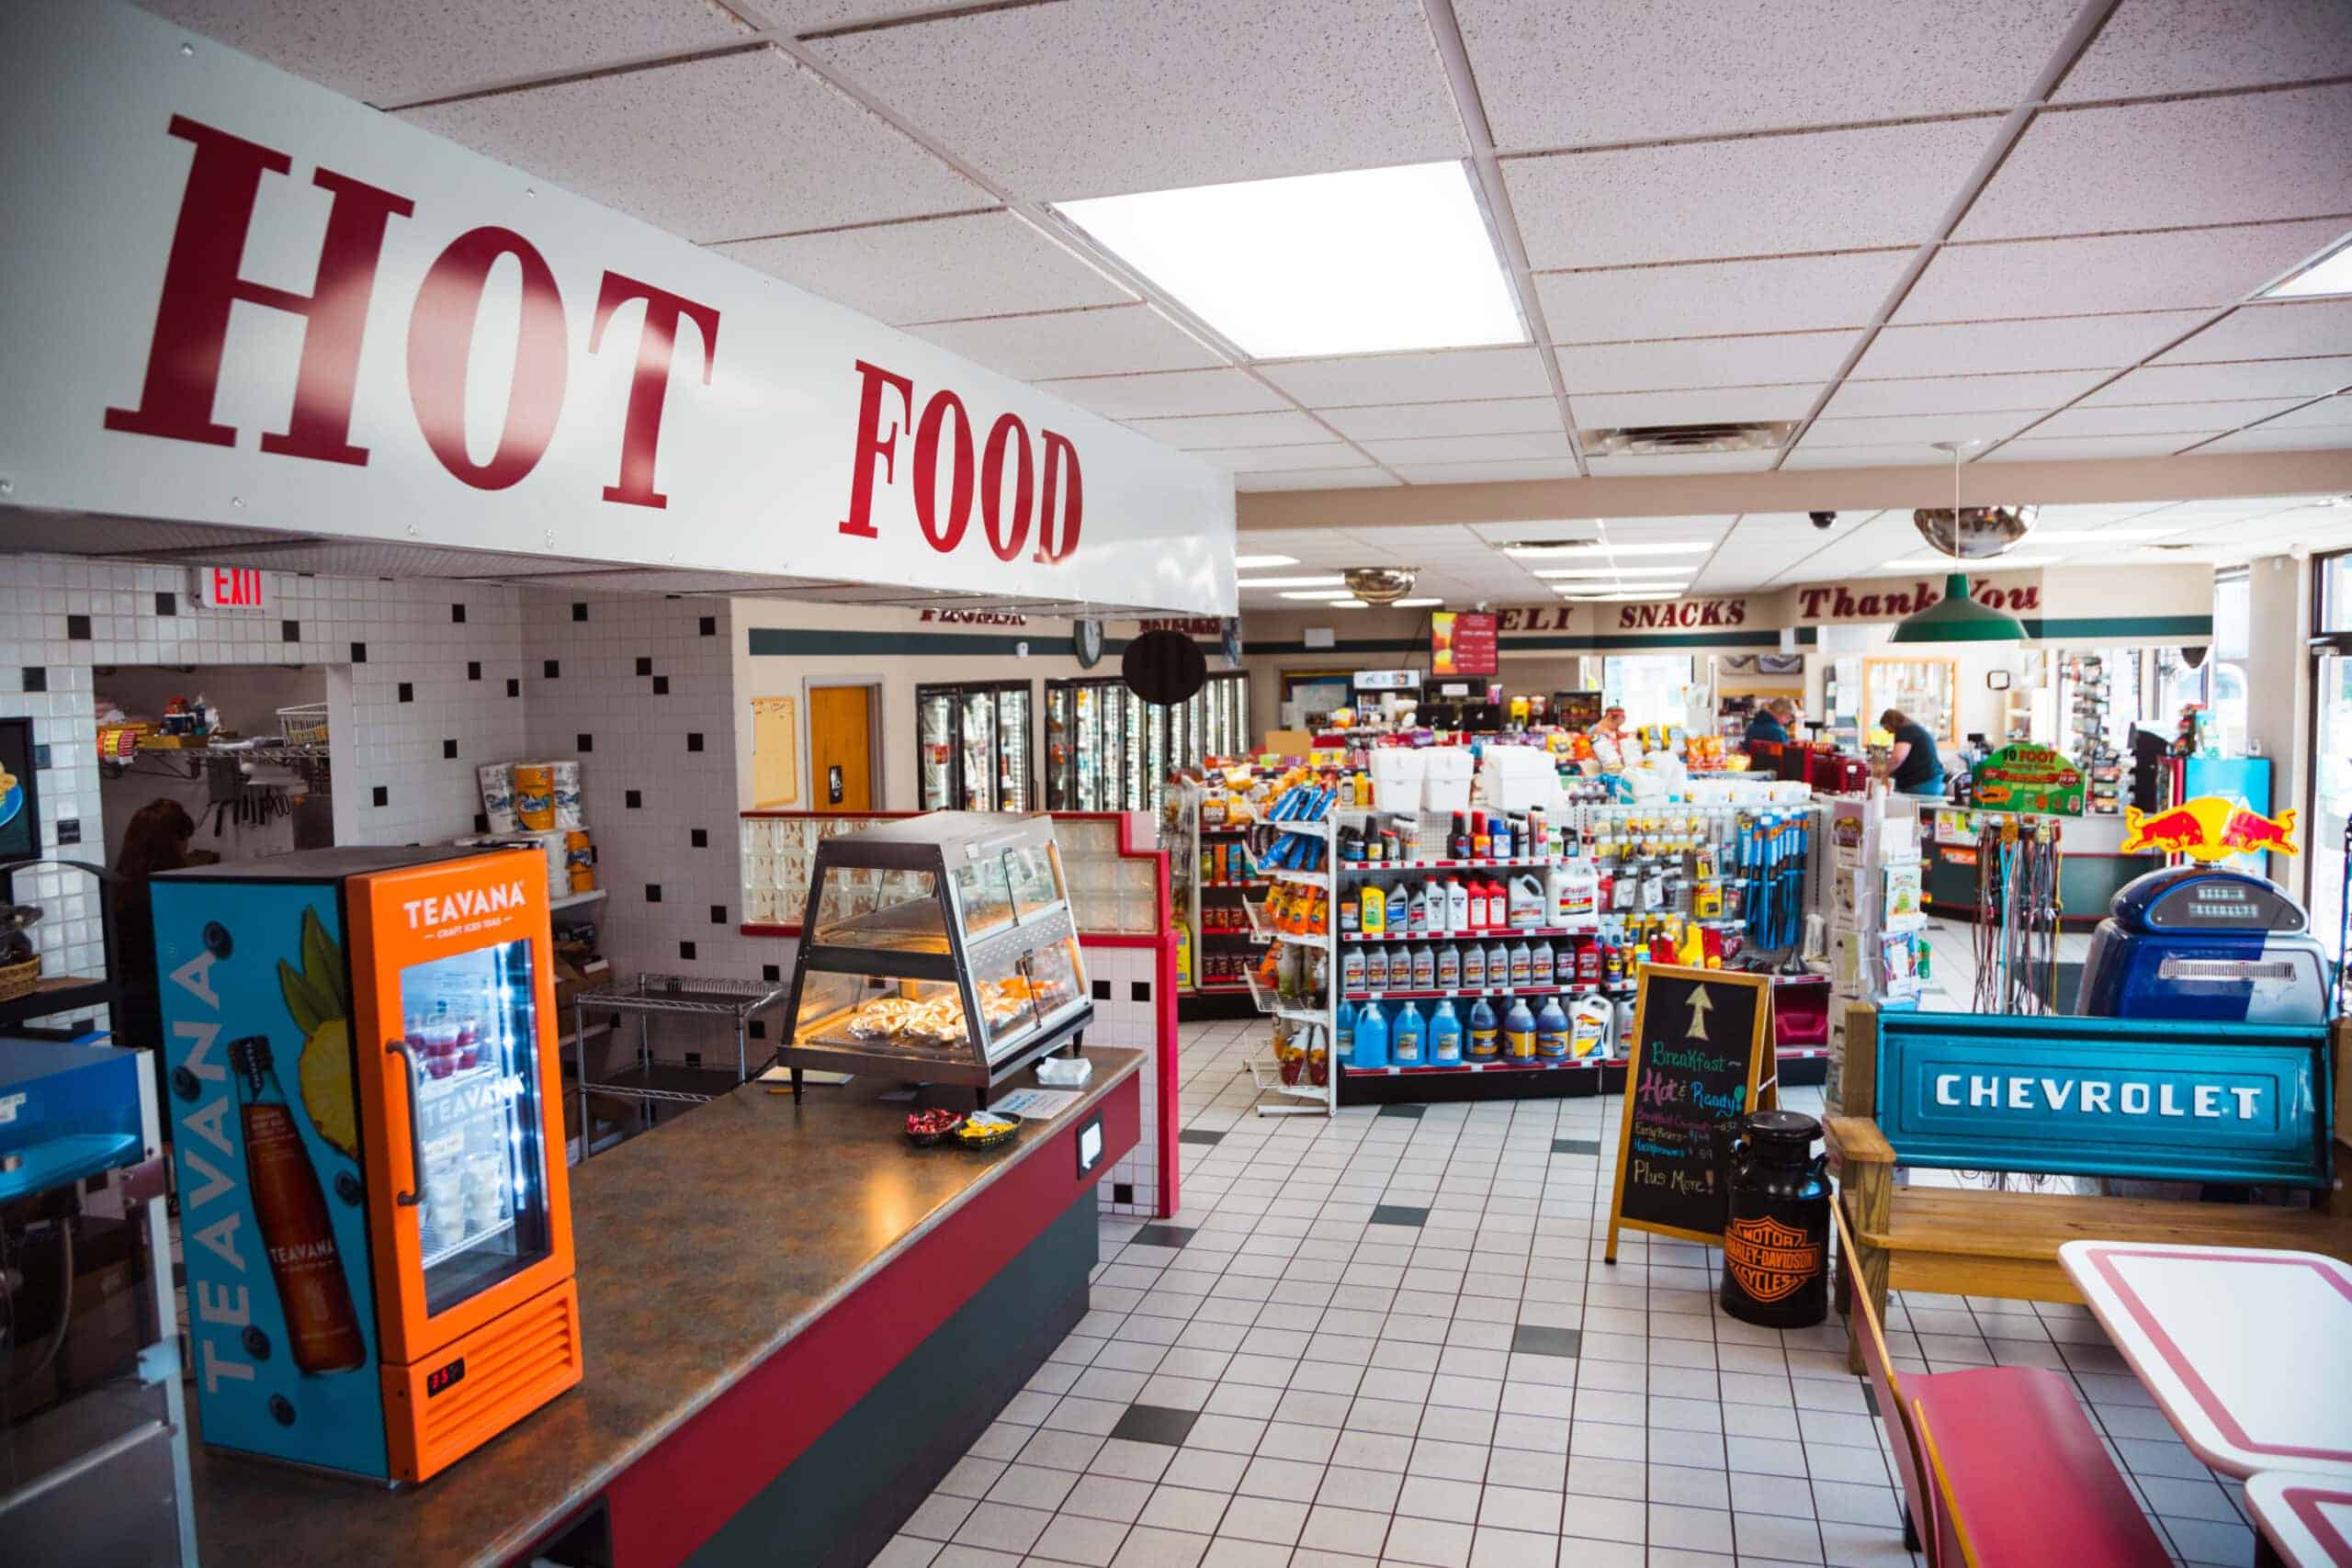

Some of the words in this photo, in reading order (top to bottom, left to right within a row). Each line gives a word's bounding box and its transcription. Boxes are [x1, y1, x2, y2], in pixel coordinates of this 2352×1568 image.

[104, 113, 720, 509] HOT
[838, 359, 1083, 565] FOOD
[214, 566, 261, 605] EXIT
[1799, 582, 1939, 618] Thank
[1498, 607, 1574, 630] ELI
[1620, 599, 1747, 629] SNACKS
[2019, 750, 2056, 762] FOOT
[403, 881, 526, 929] TEAVANA
[424, 1076, 525, 1126] TEAVANA
[1639, 1067, 1678, 1106] Hot
[1690, 1080, 1746, 1118] Ready!
[1936, 1074, 2263, 1120] CHEVROLET
[169, 949, 255, 1394] TEAVANA
[1634, 1158, 1666, 1185] Plus
[1671, 1169, 1715, 1195] More!
[268, 1240, 334, 1263] TEAVANA
[1727, 1237, 1814, 1269] HARLEY-DAVIDSON
[1742, 1226, 1794, 1247] MOTOR
[1740, 1267, 1792, 1293] CYCLES
